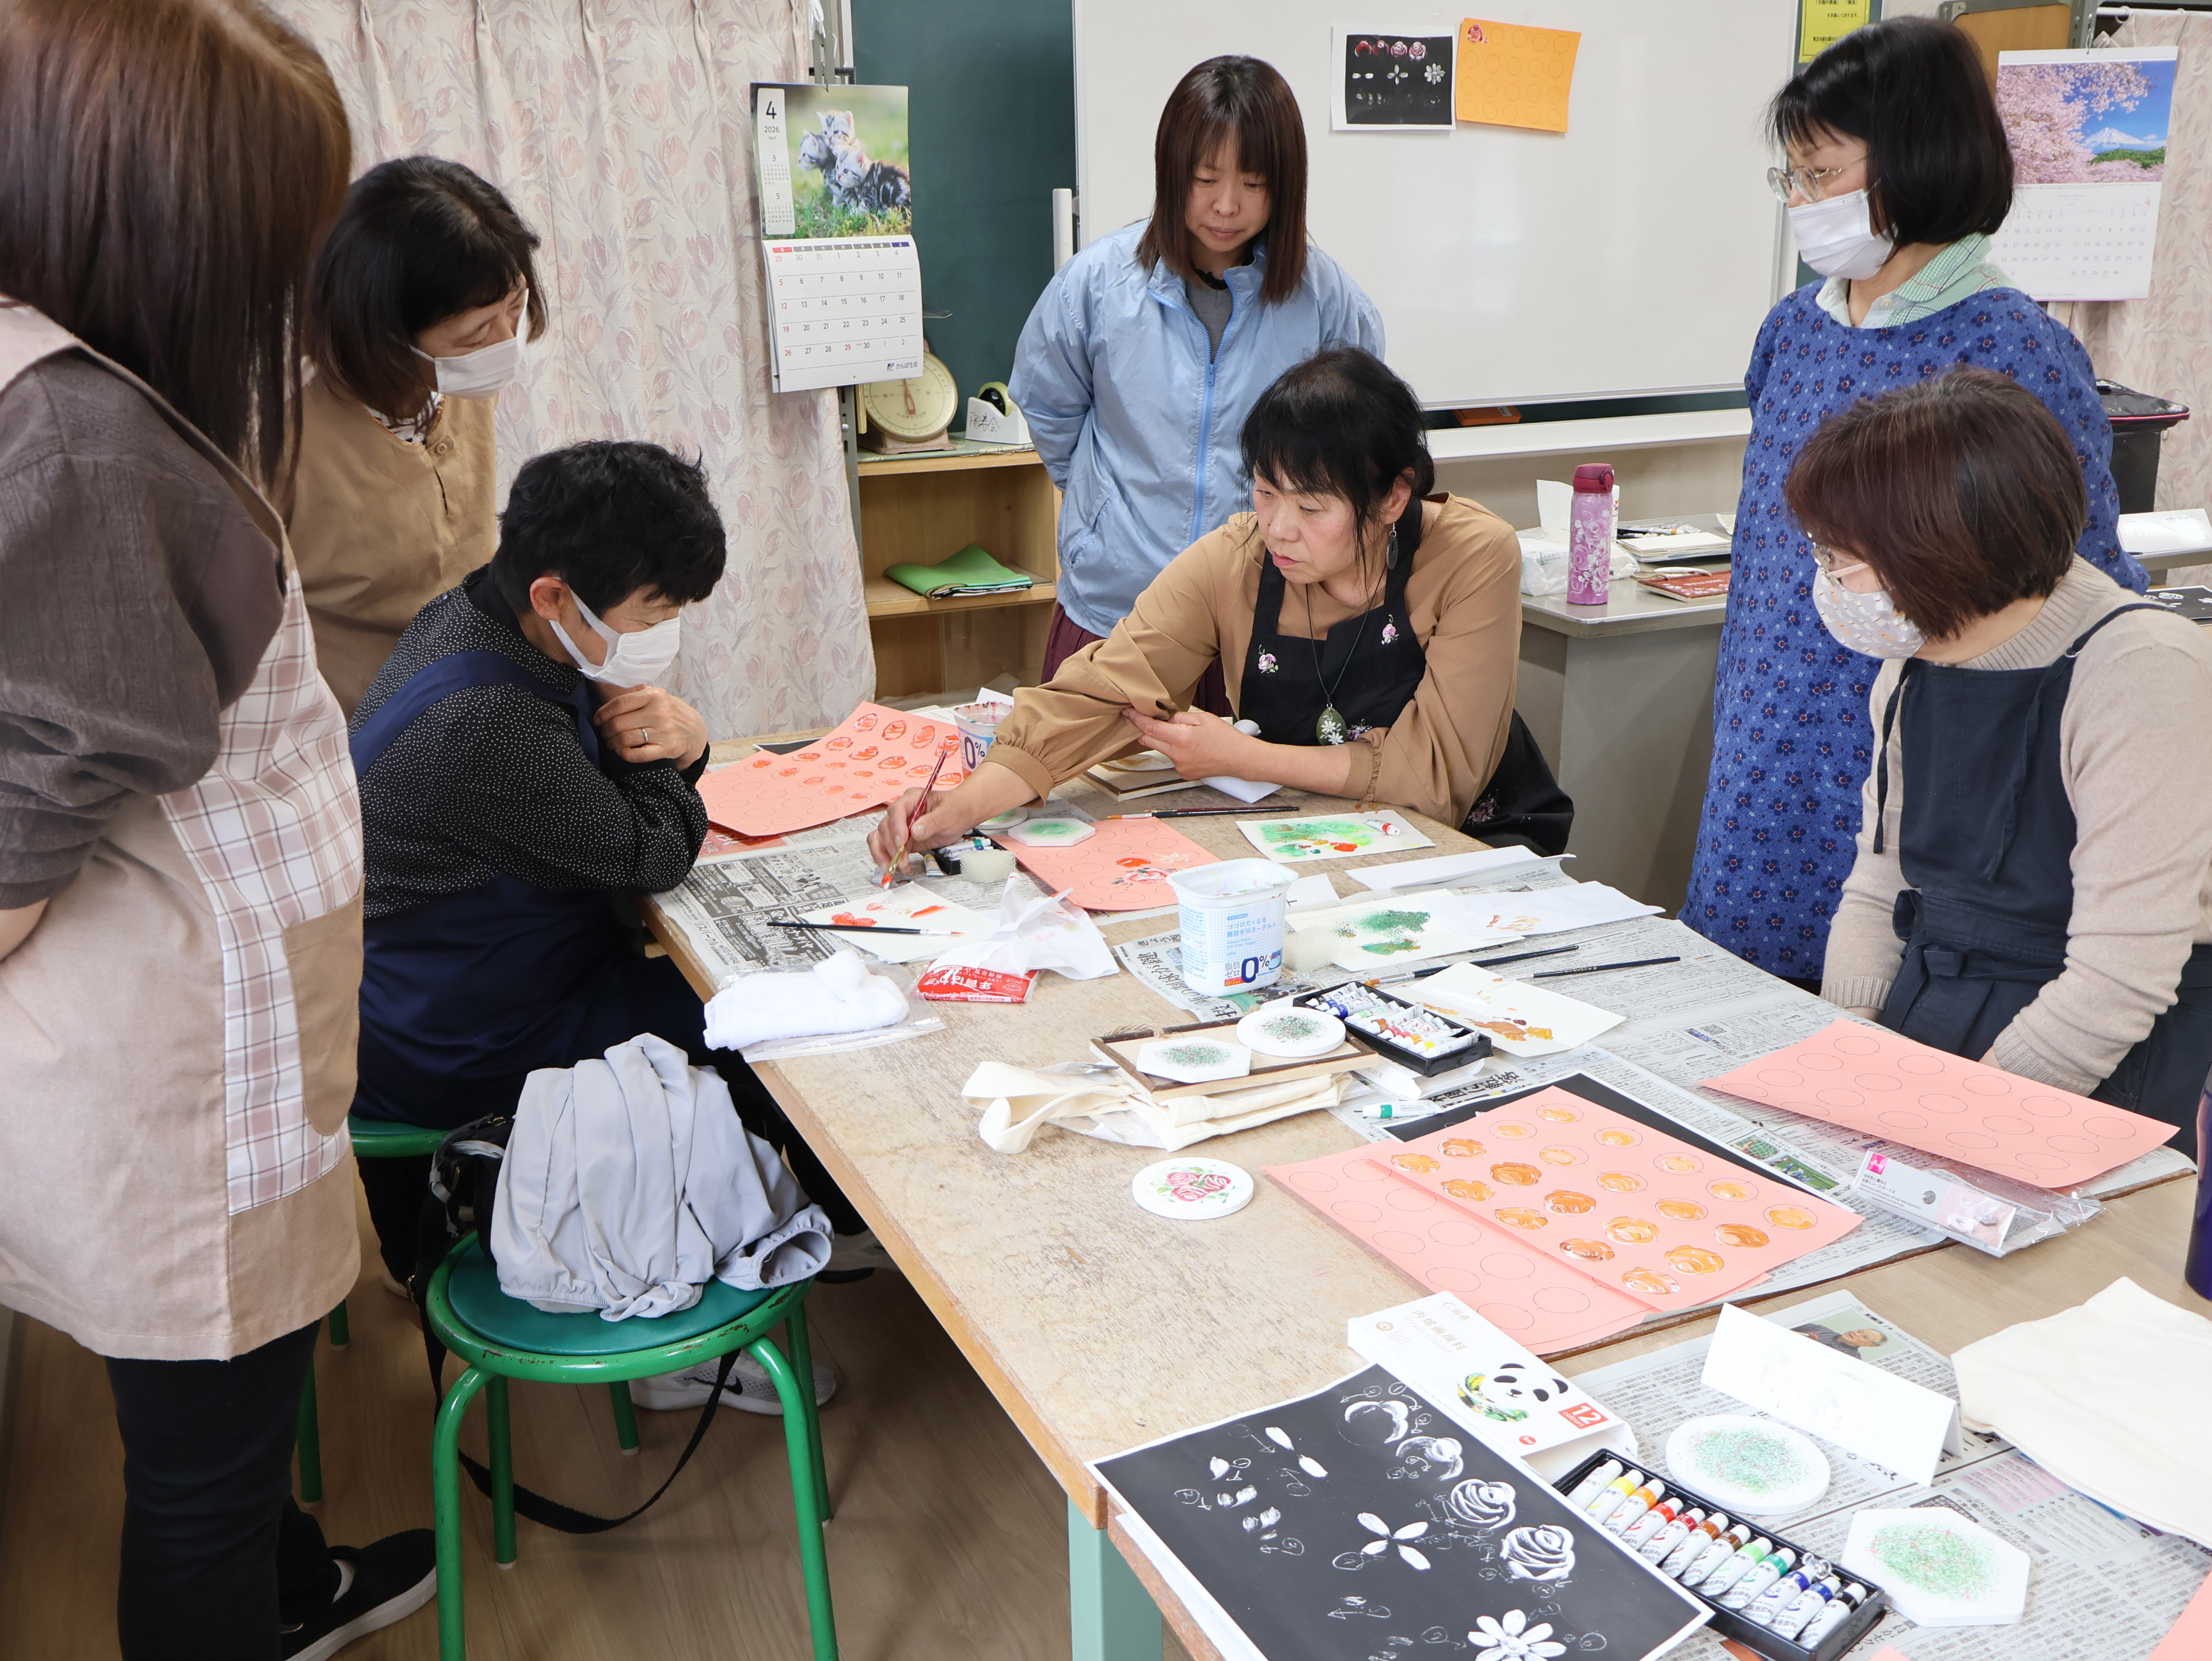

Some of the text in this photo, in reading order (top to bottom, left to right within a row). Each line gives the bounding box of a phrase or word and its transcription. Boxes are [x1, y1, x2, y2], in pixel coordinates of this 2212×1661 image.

[766, 101, 776, 119] 4
[2145, 197, 2151, 206] 4
[1227, 917, 1266, 929] つづけたくなる
[1227, 922, 1276, 937] 脂肪ゼロヨーグルト
[1225, 961, 1241, 970] 脂肪
[1241, 955, 1270, 983] 0%
[923, 972, 993, 990] 年賀はがき
[1411, 1309, 1468, 1350] 丙烯画颜料
[1563, 1411, 1586, 1427] colours
[1572, 1405, 1602, 1424] 12
